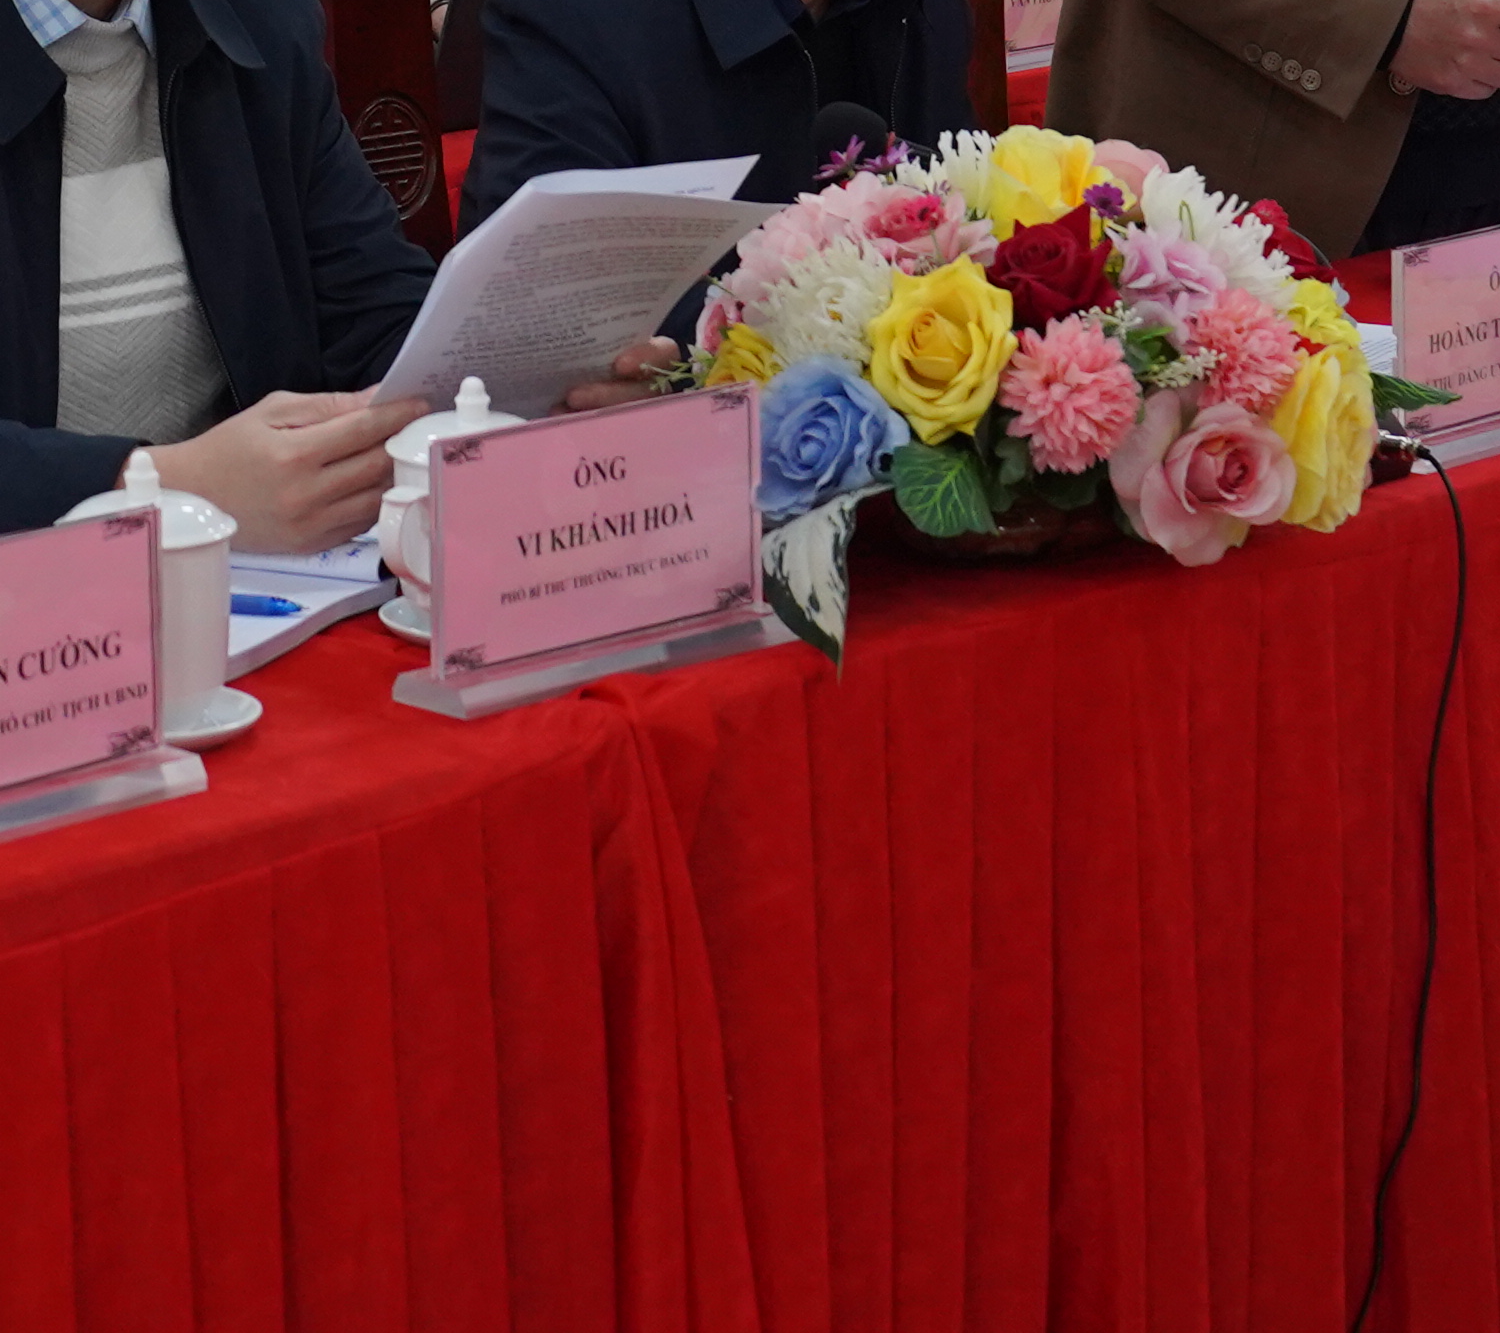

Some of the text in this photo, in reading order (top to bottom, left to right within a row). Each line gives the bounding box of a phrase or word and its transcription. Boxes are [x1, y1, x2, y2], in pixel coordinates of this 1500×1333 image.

[1428, 321, 1488, 355] HOÀNG
[573, 455, 627, 489] ÔNG
[516, 530, 542, 558] VI
[549, 511, 637, 553] KHÁNH
[17, 630, 123, 681] CƯỜNG
